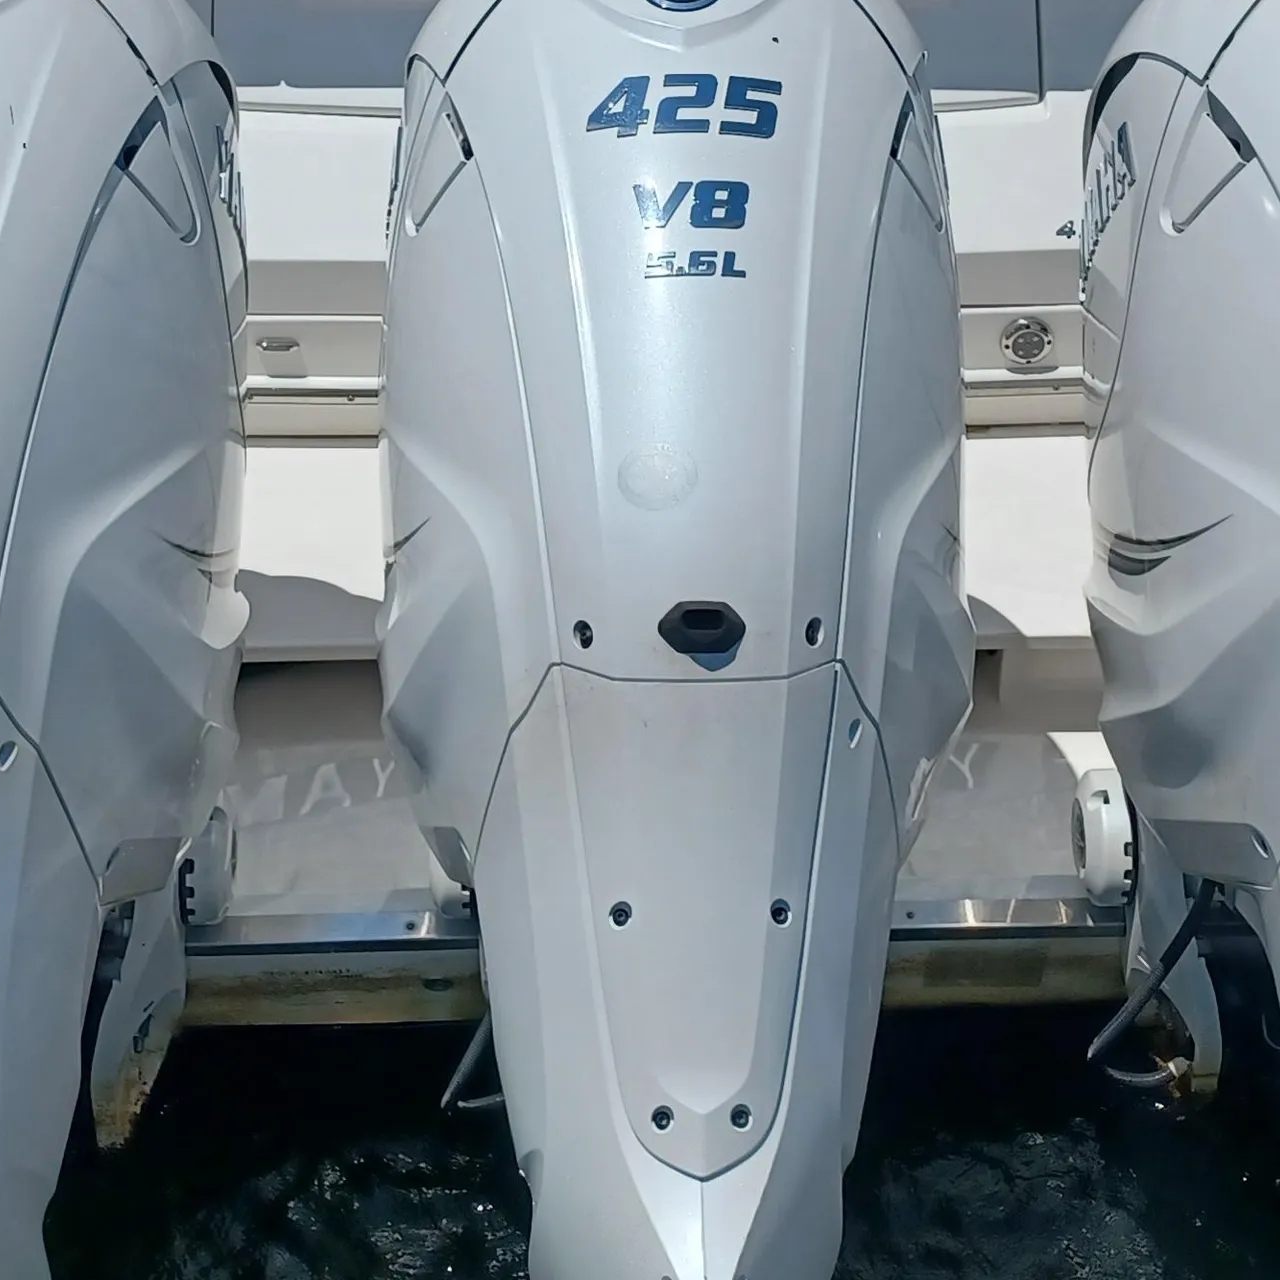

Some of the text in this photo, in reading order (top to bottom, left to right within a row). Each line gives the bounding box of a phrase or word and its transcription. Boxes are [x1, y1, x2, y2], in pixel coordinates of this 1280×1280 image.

[585, 73, 783, 139] 425
[632, 179, 750, 230] V8
[644, 250, 747, 279] 5.6L
